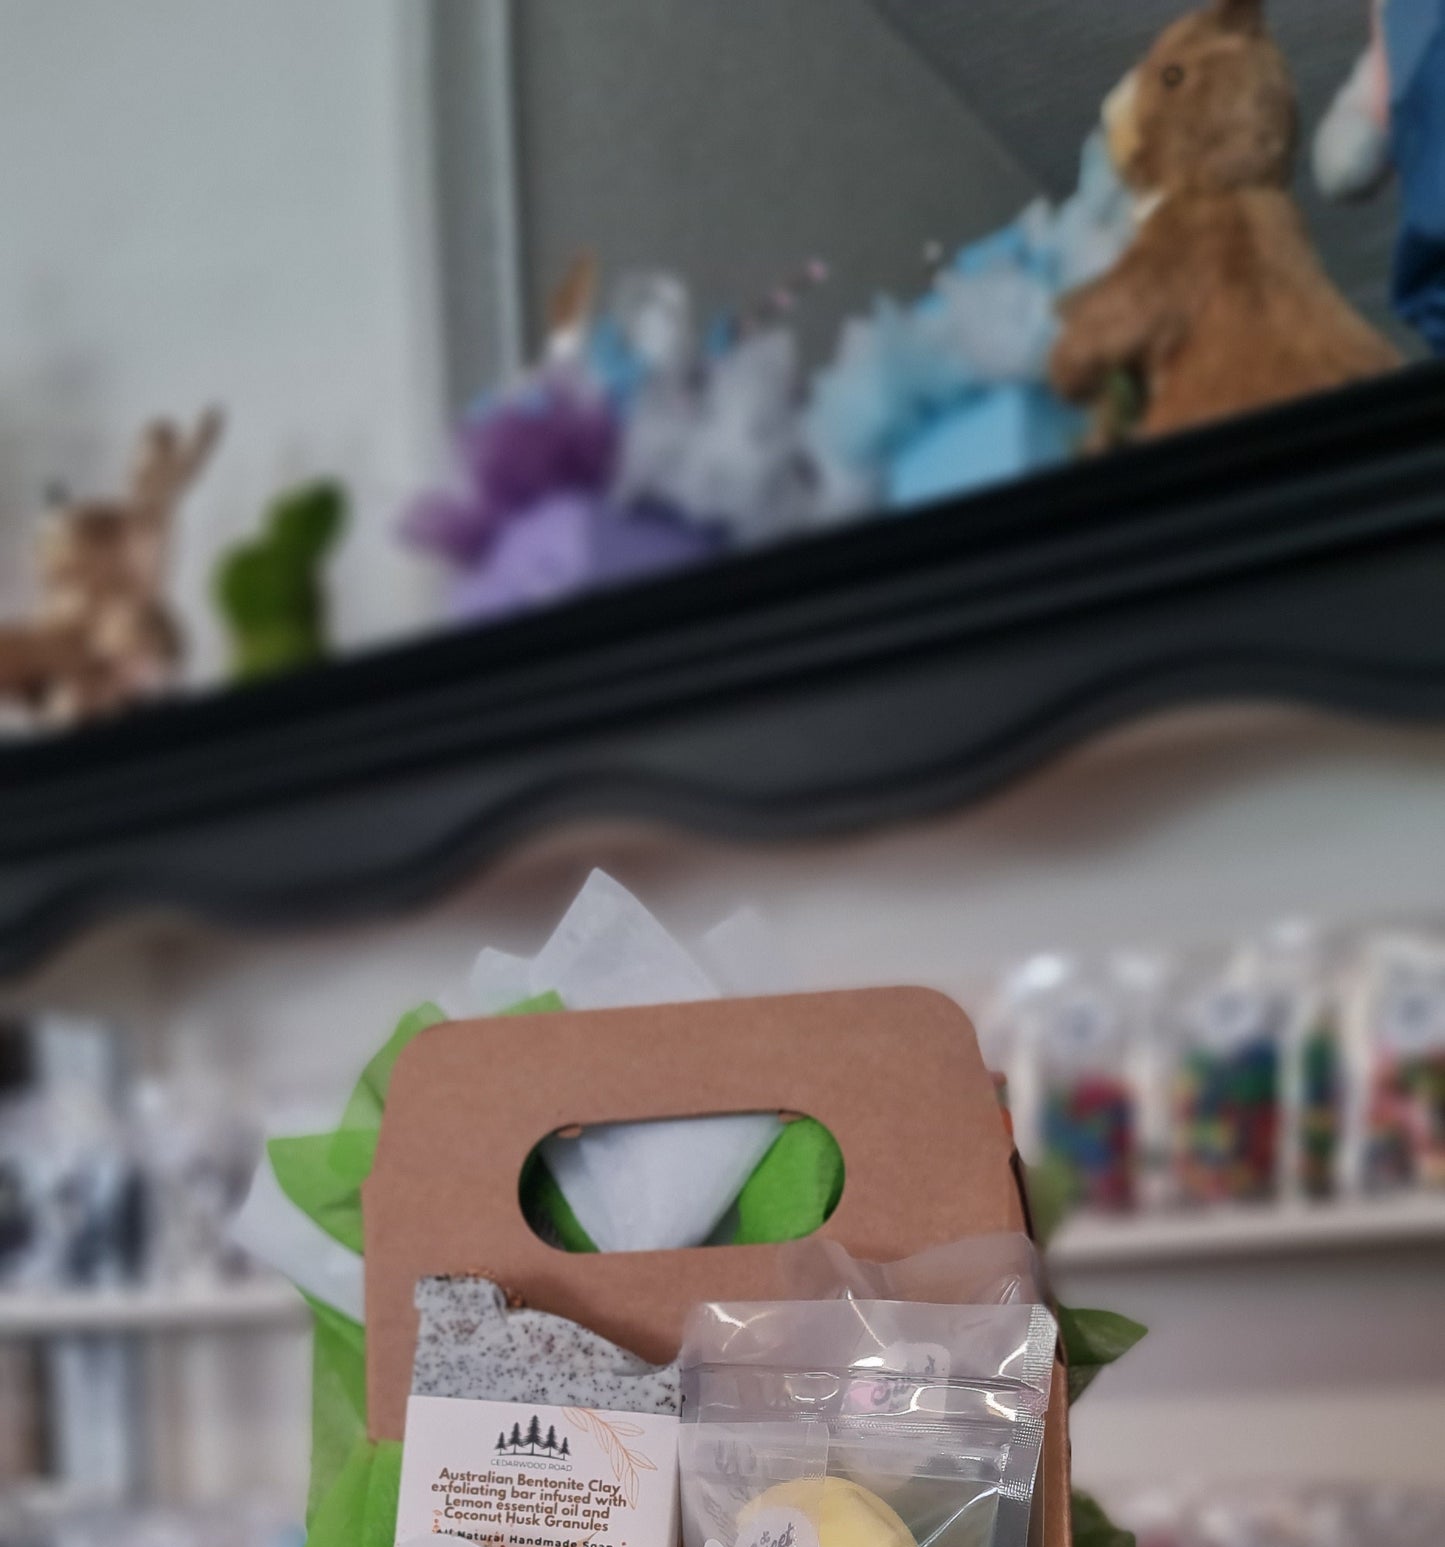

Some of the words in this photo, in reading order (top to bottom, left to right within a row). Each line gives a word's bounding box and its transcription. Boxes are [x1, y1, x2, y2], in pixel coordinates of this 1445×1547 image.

[490, 1458, 547, 1470] CEDARWOOD
[549, 1462, 573, 1472] ROAD
[439, 1467, 513, 1486] Australian
[517, 1473, 584, 1491] Bentonite
[588, 1479, 621, 1495] Clay
[431, 1481, 507, 1500] exfoliating
[511, 1486, 536, 1500] bar
[540, 1488, 591, 1504] infused
[594, 1494, 627, 1508] with
[445, 1494, 492, 1509] Lemon
[496, 1498, 558, 1515] essential
[561, 1504, 578, 1517] oil
[582, 1507, 610, 1519] and
[444, 1507, 502, 1524] Coconut
[505, 1511, 541, 1526] Husk
[544, 1515, 609, 1532] Granules
[457, 1530, 504, 1543] Natural
